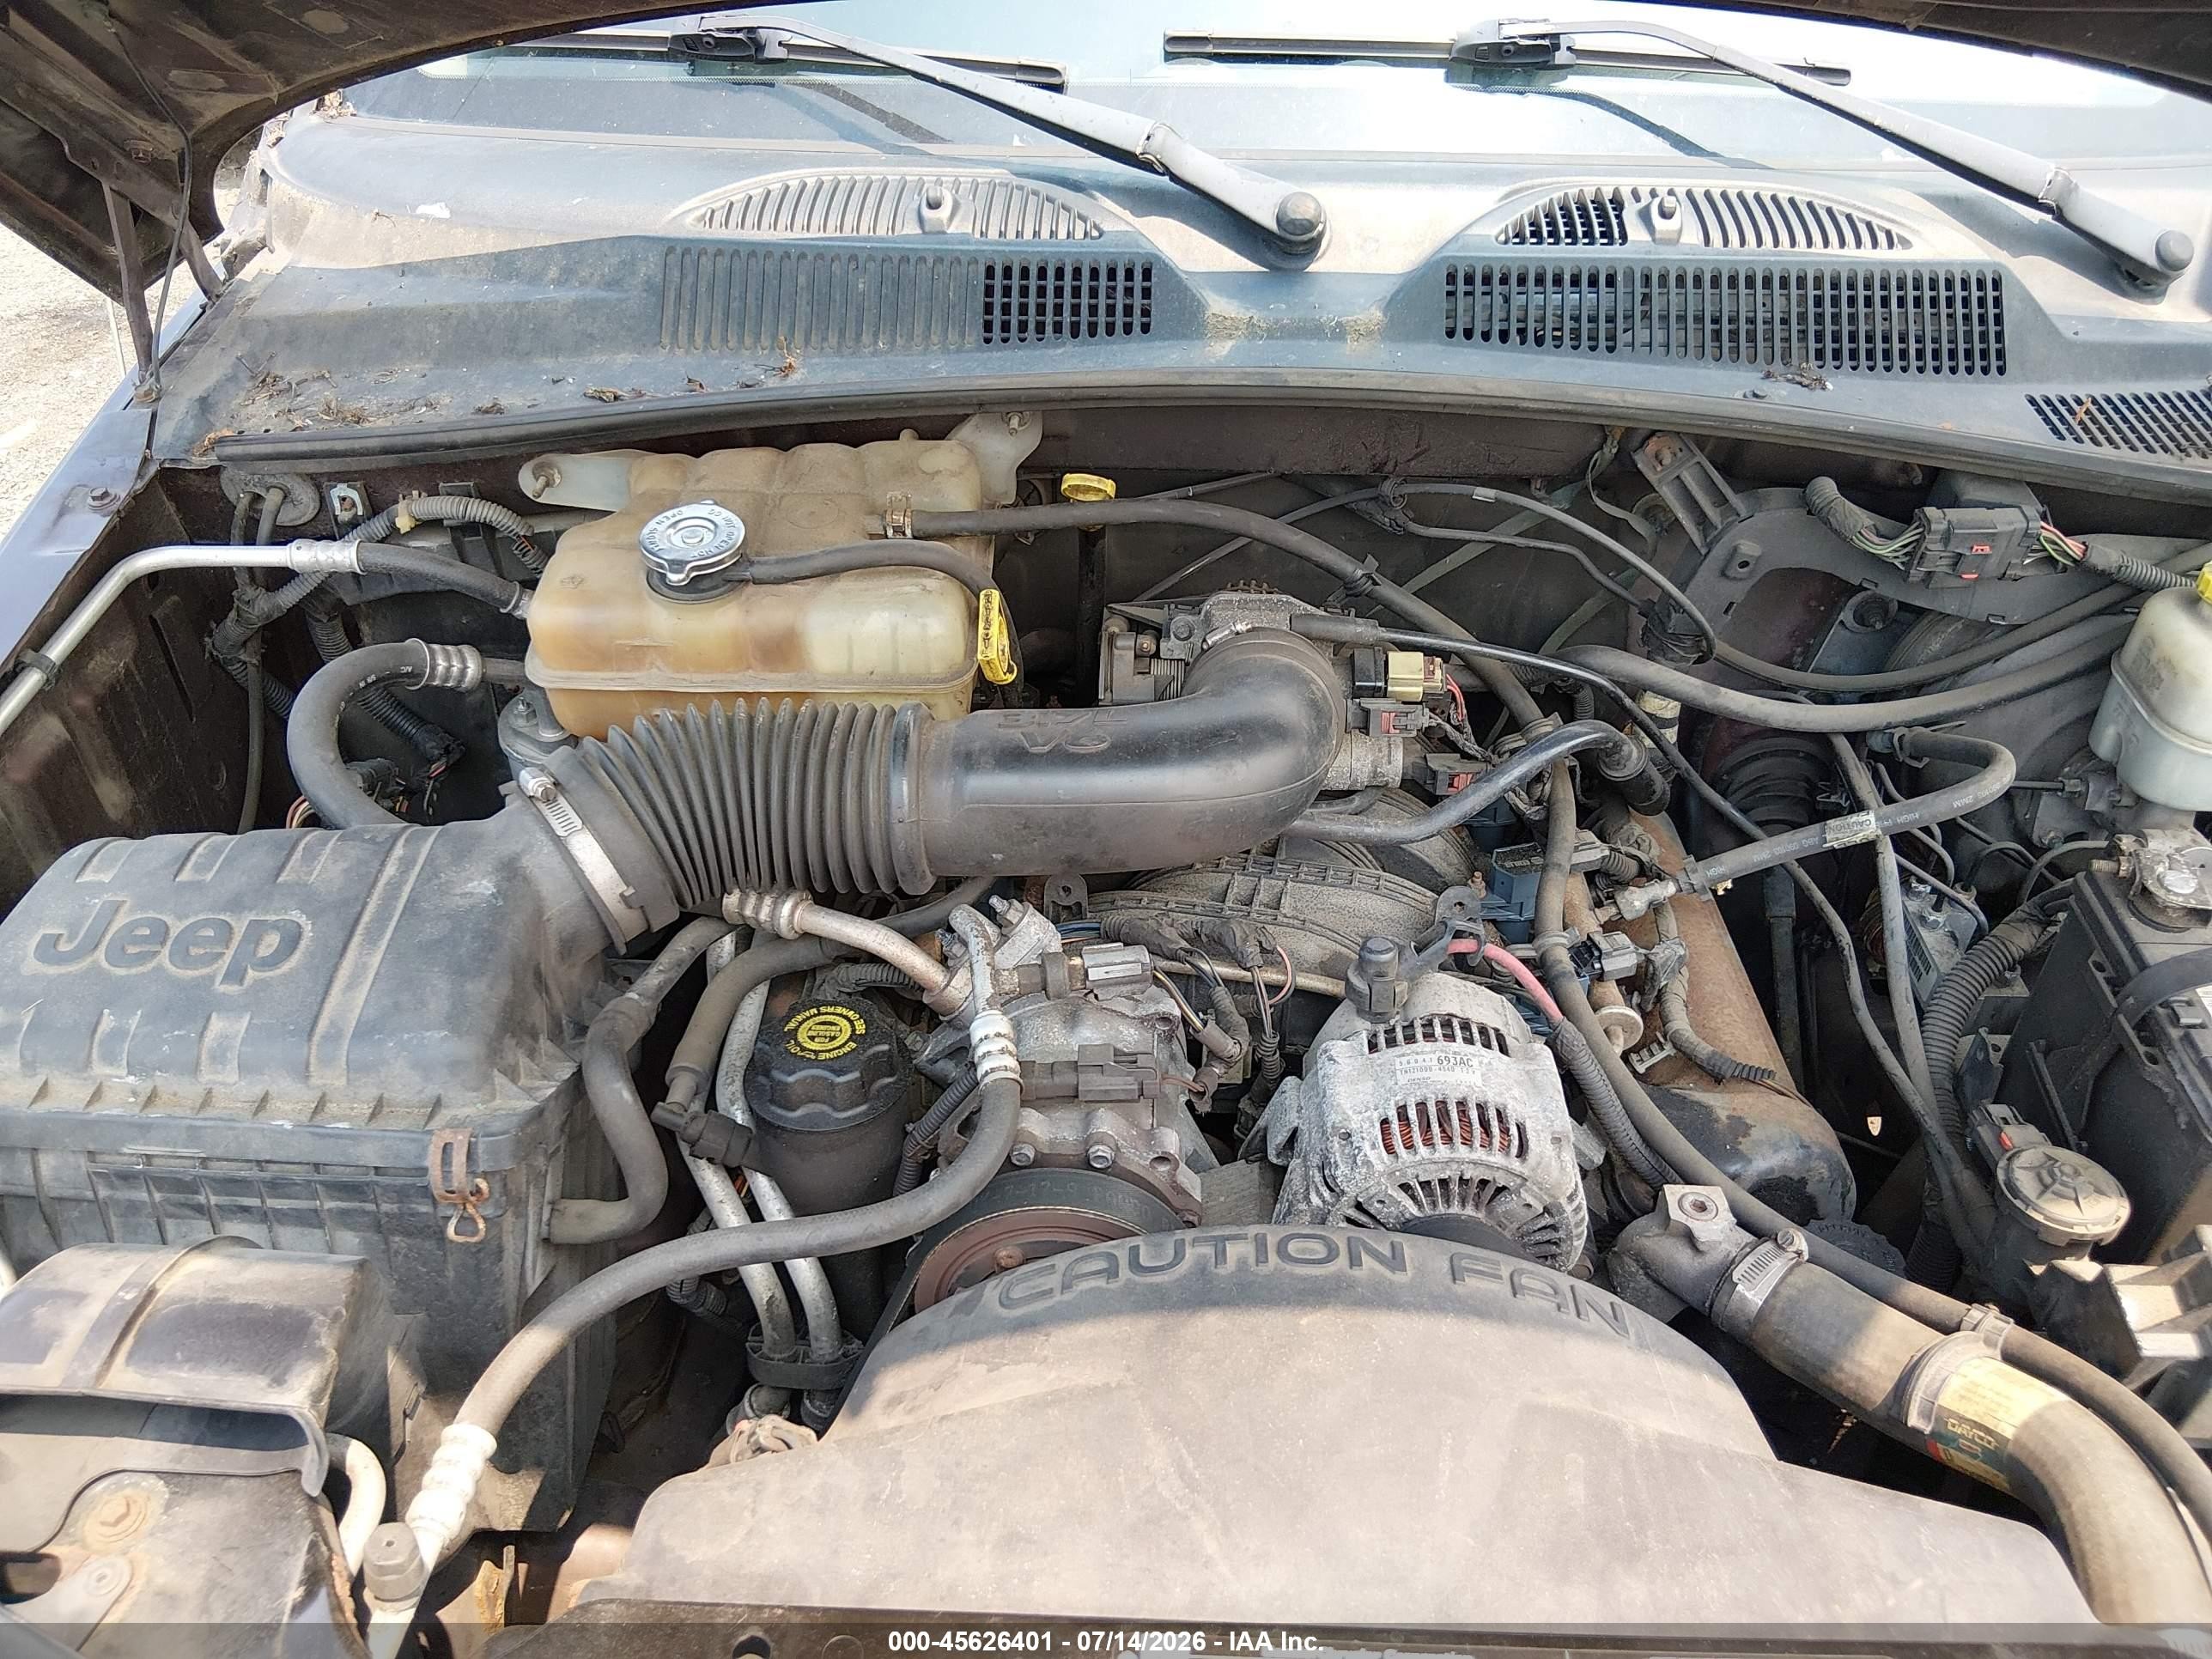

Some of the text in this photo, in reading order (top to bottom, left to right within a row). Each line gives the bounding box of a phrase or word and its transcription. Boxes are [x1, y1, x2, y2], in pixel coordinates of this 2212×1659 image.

[655, 509, 684, 526] OPEN
[1825, 818, 1872, 833] CAUTION
[1896, 811, 1920, 823] HIGH
[33, 898, 307, 988] Jeep
[784, 1006, 866, 1035] SEE OWNERS MANUAL
[785, 1039, 857, 1060] ENGINE OIL
[1437, 1055, 1474, 1067] 693AC
[998, 1231, 1631, 1338] CAUTION FAN
[1944, 1418, 2000, 1450] DAYCO
